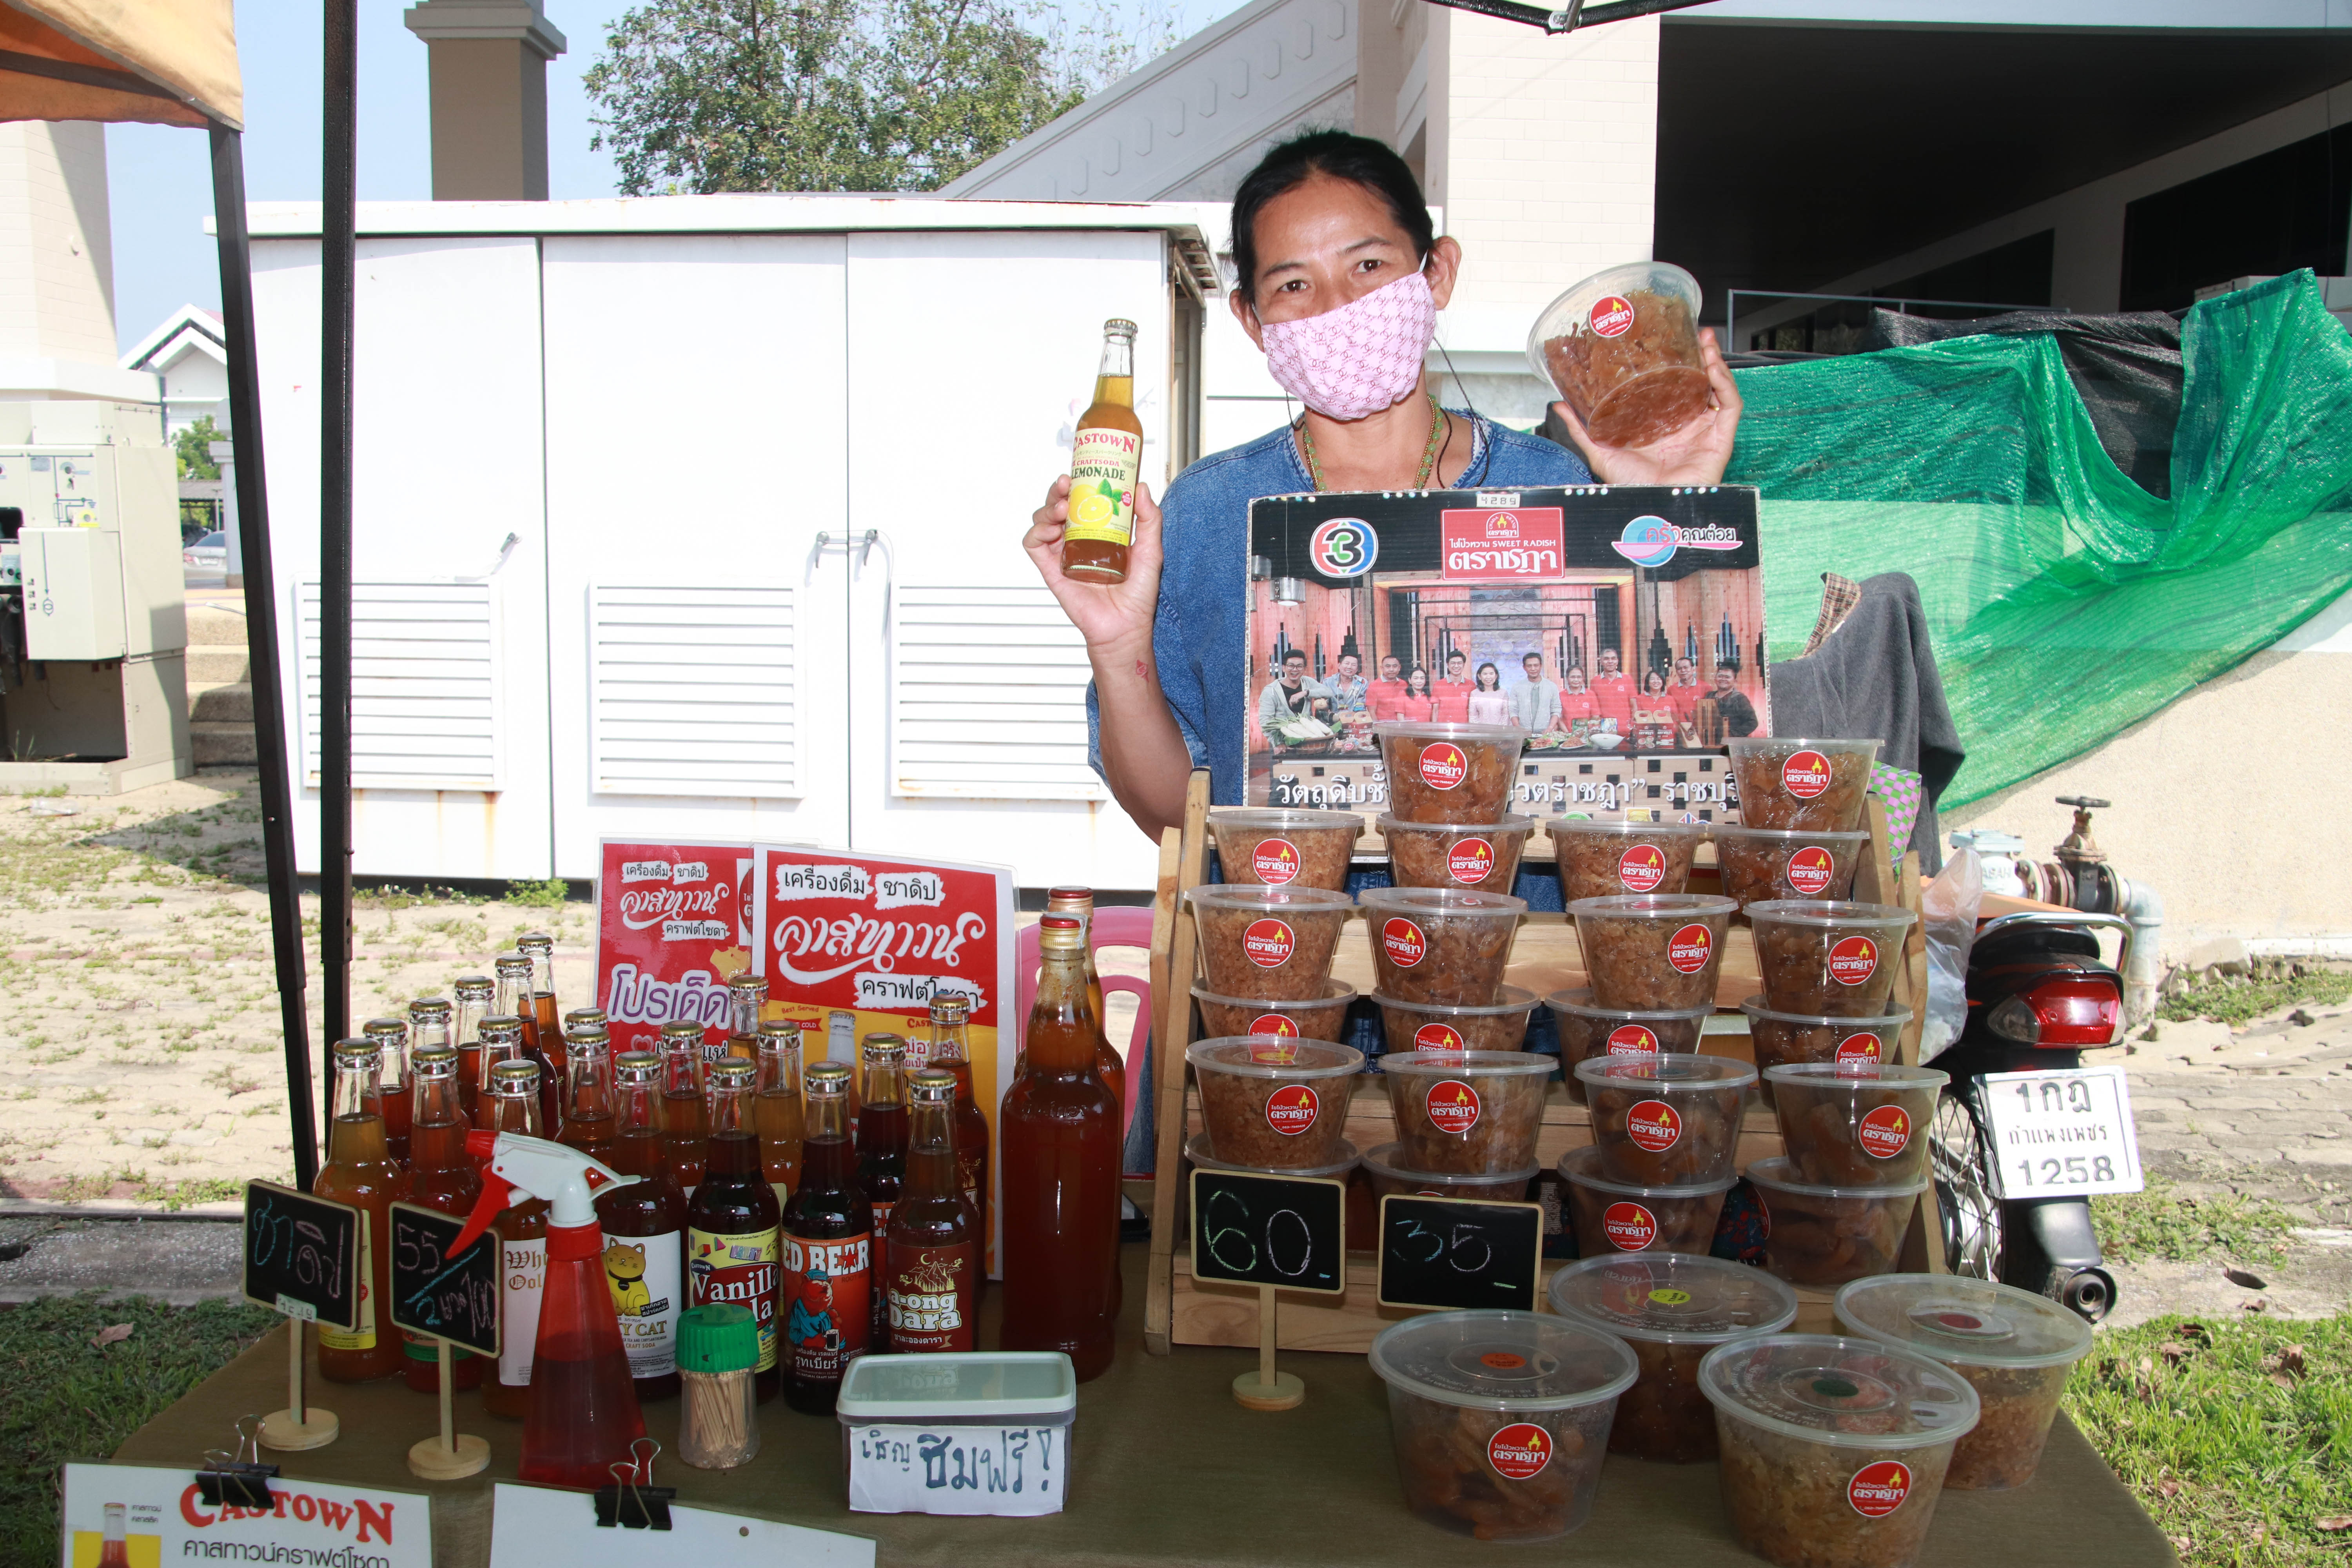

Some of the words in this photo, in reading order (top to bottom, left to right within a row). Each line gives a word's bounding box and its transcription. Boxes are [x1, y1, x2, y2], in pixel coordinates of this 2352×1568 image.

[1071, 466, 1126, 481] LEMONADE
[1481, 496, 1517, 505] 4289
[1448, 548, 1558, 573] ตราชฎา
[1276, 763, 1390, 810] วัตถุดิบชั้
[627, 861, 668, 877] เครื่องดื่ม
[677, 865, 704, 878] ชาดิป
[784, 864, 865, 895] เครื่องดื่ม
[883, 876, 936, 902] ชาดิป
[666, 921, 726, 937] คราฟต์โซดา
[862, 976, 979, 1008] คราฟต์โา
[2009, 1123, 2108, 1145] กำแพงเพชร
[2018, 1154, 2114, 1186] 1258
[397, 1222, 440, 1275] 55
[783, 1237, 804, 1273] ED
[808, 1239, 869, 1276] BEAR
[692, 1265, 779, 1301] Vanilla
[635, 1320, 667, 1336] CAT
[890, 1305, 962, 1331] Dara
[894, 1333, 942, 1344] ชาละอองดารา
[795, 1356, 838, 1369] รูทเบียร์
[862, 1429, 910, 1471] เชิญ
